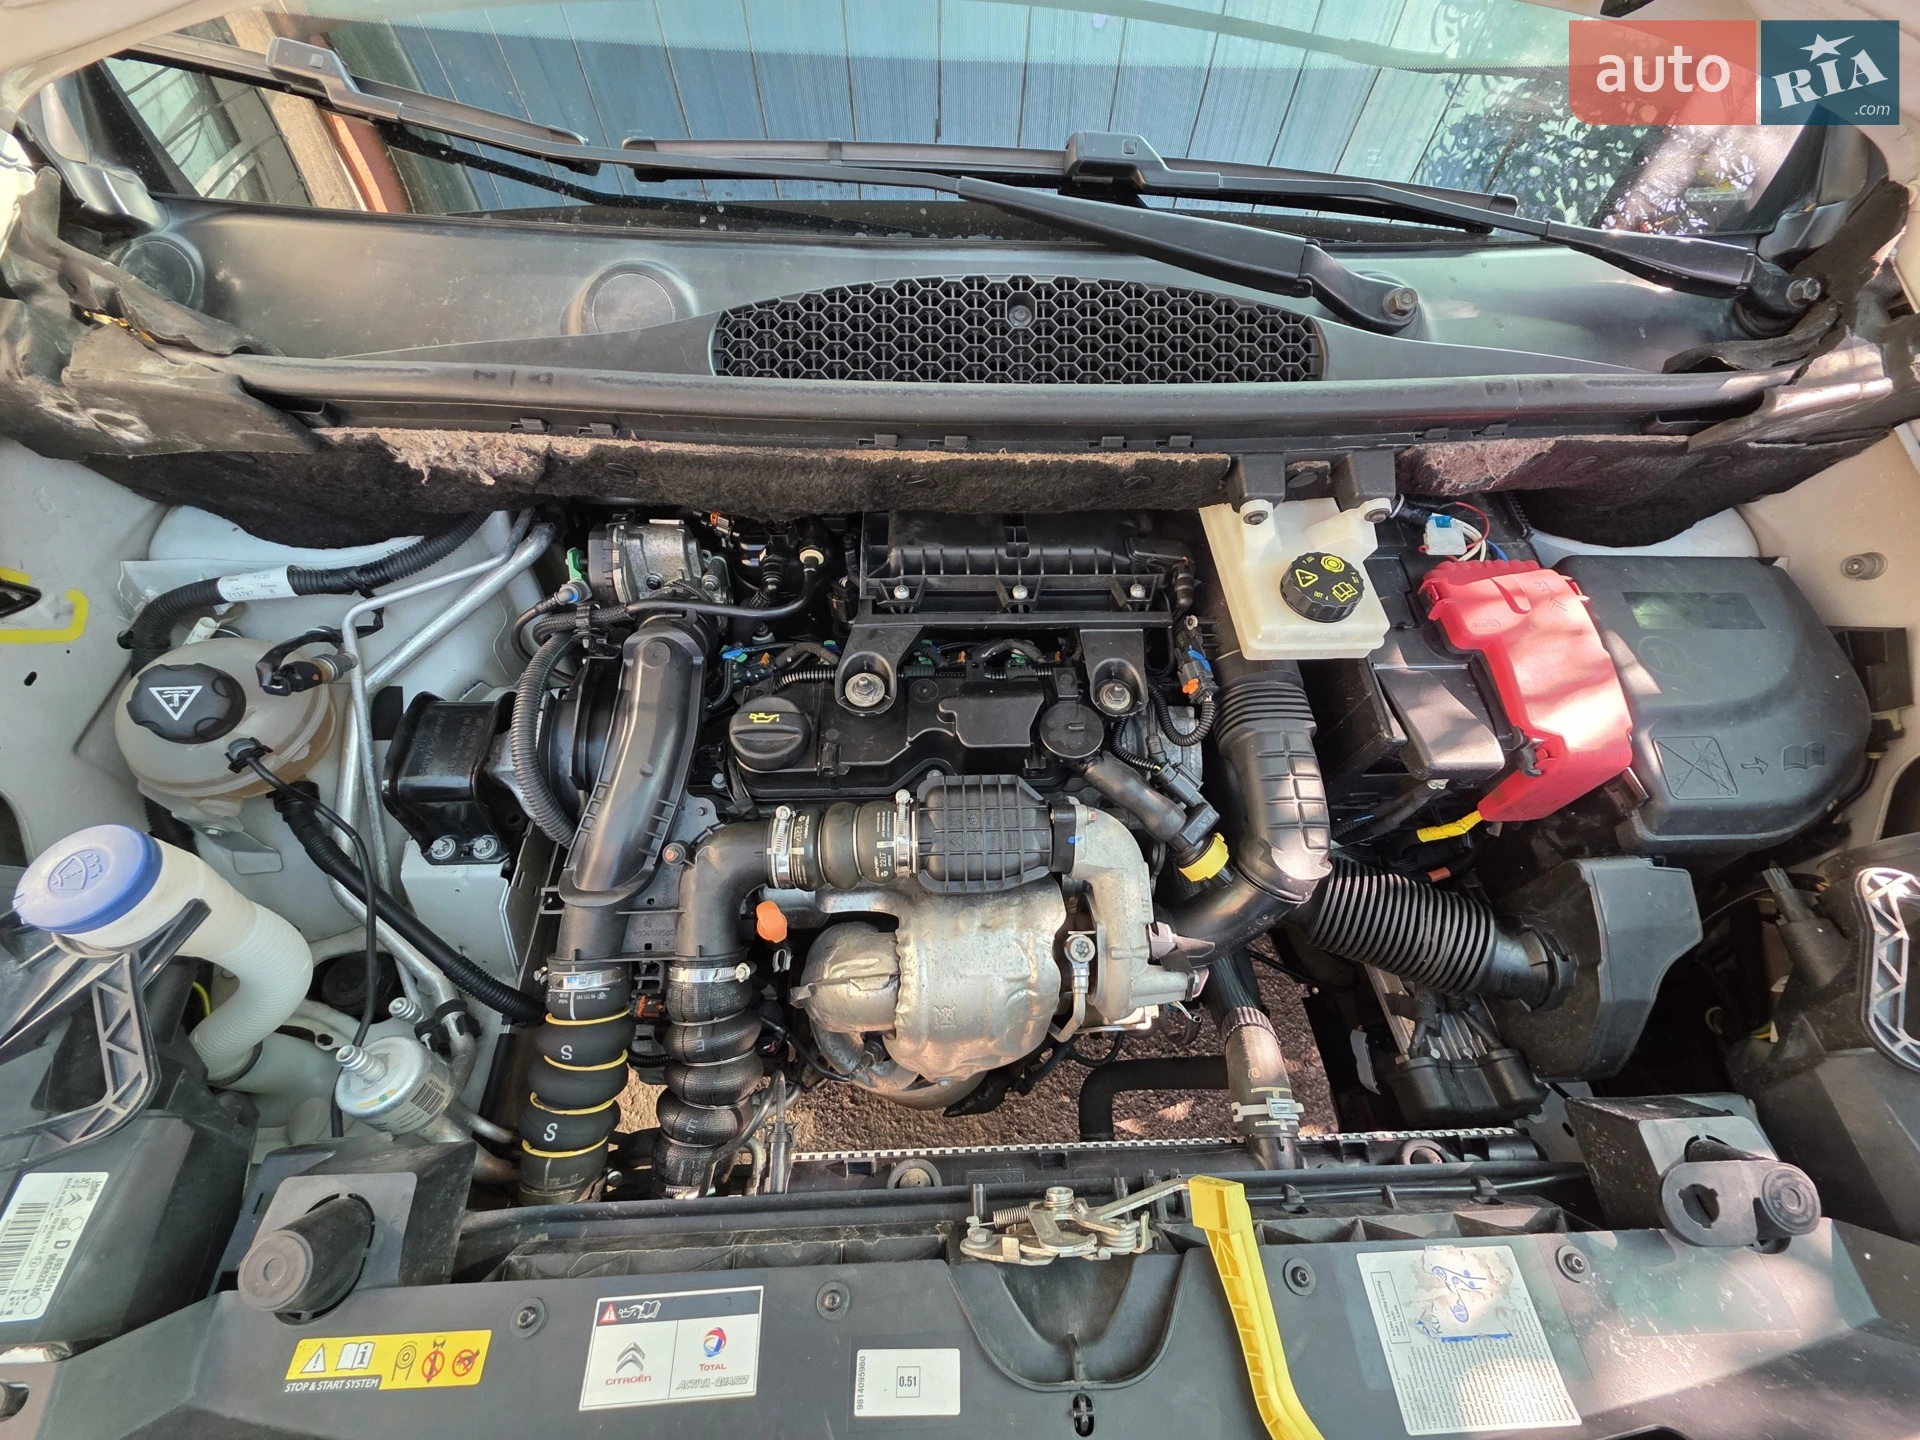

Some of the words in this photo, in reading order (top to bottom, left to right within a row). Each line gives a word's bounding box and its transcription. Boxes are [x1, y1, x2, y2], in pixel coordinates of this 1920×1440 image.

[560, 1045, 572, 1061] S
[543, 1123, 558, 1142] S
[54, 1240, 71, 1249] D
[699, 1363, 726, 1371] TOTAL
[285, 1383, 308, 1392] STOP
[308, 1382, 316, 1391] &
[317, 1381, 346, 1391] START
[345, 1378, 380, 1389] SYSTEM
[676, 1377, 711, 1390] ACTIVA
[715, 1375, 749, 1387] QUARTZ
